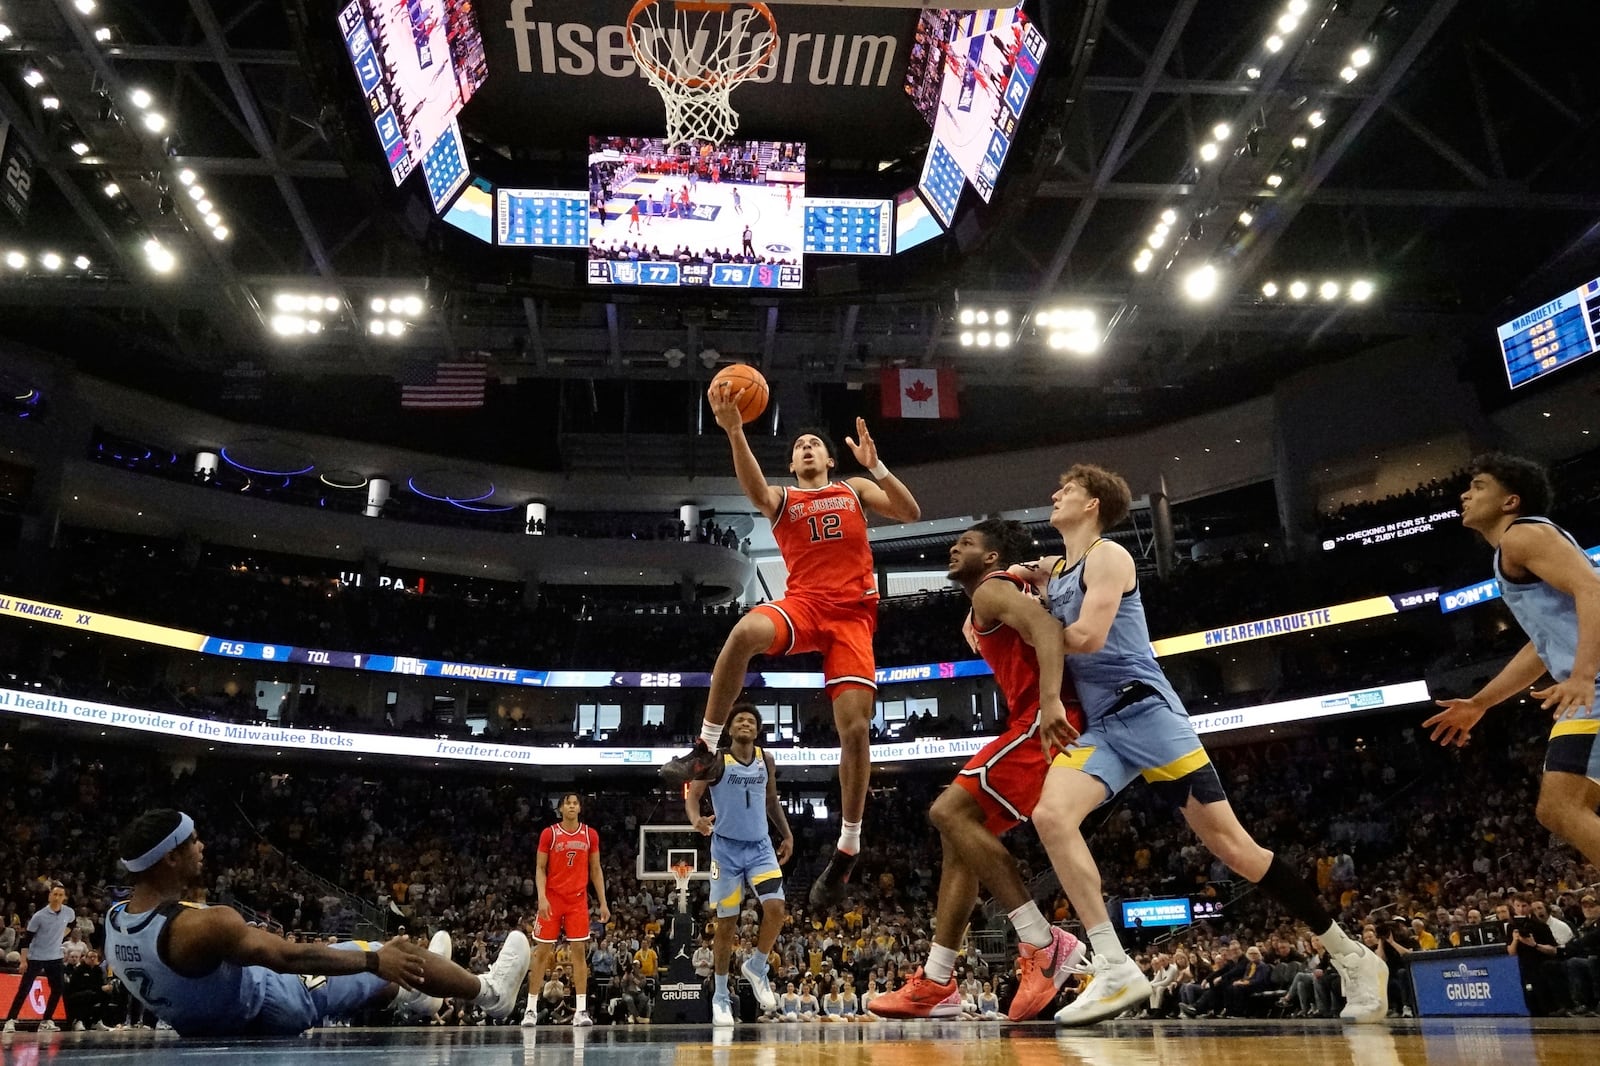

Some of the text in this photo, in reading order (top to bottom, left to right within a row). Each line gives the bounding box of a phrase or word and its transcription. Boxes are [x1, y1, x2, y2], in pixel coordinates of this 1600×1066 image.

[720, 8, 898, 87] forum
[649, 267, 669, 280] 77
[1512, 299, 1563, 331] MARQUETTE
[1534, 342, 1559, 360] 50.0
[807, 513, 843, 543] 12
[1346, 526, 1386, 541] CHECKING
[1387, 524, 1396, 532] IN
[1396, 519, 1414, 530] FOR
[1414, 516, 1427, 526] ST.
[1375, 532, 1396, 543] ZUBY
[1445, 583, 1493, 609] DON'T
[14, 601, 63, 620] TRACKER:
[76, 614, 91, 625] XX
[1205, 609, 1331, 645] #WEAREMARQUETTE
[219, 642, 244, 656] FLS
[262, 646, 275, 659] 9
[307, 651, 330, 664] TOL
[353, 655, 361, 668] 1
[440, 663, 518, 681] MARQUETTE
[640, 673, 681, 688] 2:52
[889, 666, 931, 680] JOHN'S
[14, 694, 68, 714] health
[73, 705, 108, 719] care
[111, 711, 176, 729] provider
[179, 720, 195, 732] of
[198, 723, 220, 736] the
[224, 726, 306, 743] Milwaukee
[310, 733, 354, 747] Bucks
[1191, 714, 1244, 729] ert.com
[436, 742, 531, 760] froedtert.com
[775, 751, 816, 761] health
[820, 752, 840, 761] car
[871, 746, 904, 758] vider
[908, 745, 920, 755] of
[925, 744, 945, 754] the
[745, 789, 751, 810] 1
[566, 851, 576, 867] 7
[115, 944, 142, 961] ROSS
[124, 967, 172, 1007] 2
[661, 991, 700, 1001] GRUBER
[1446, 982, 1492, 1000] GRUBER
